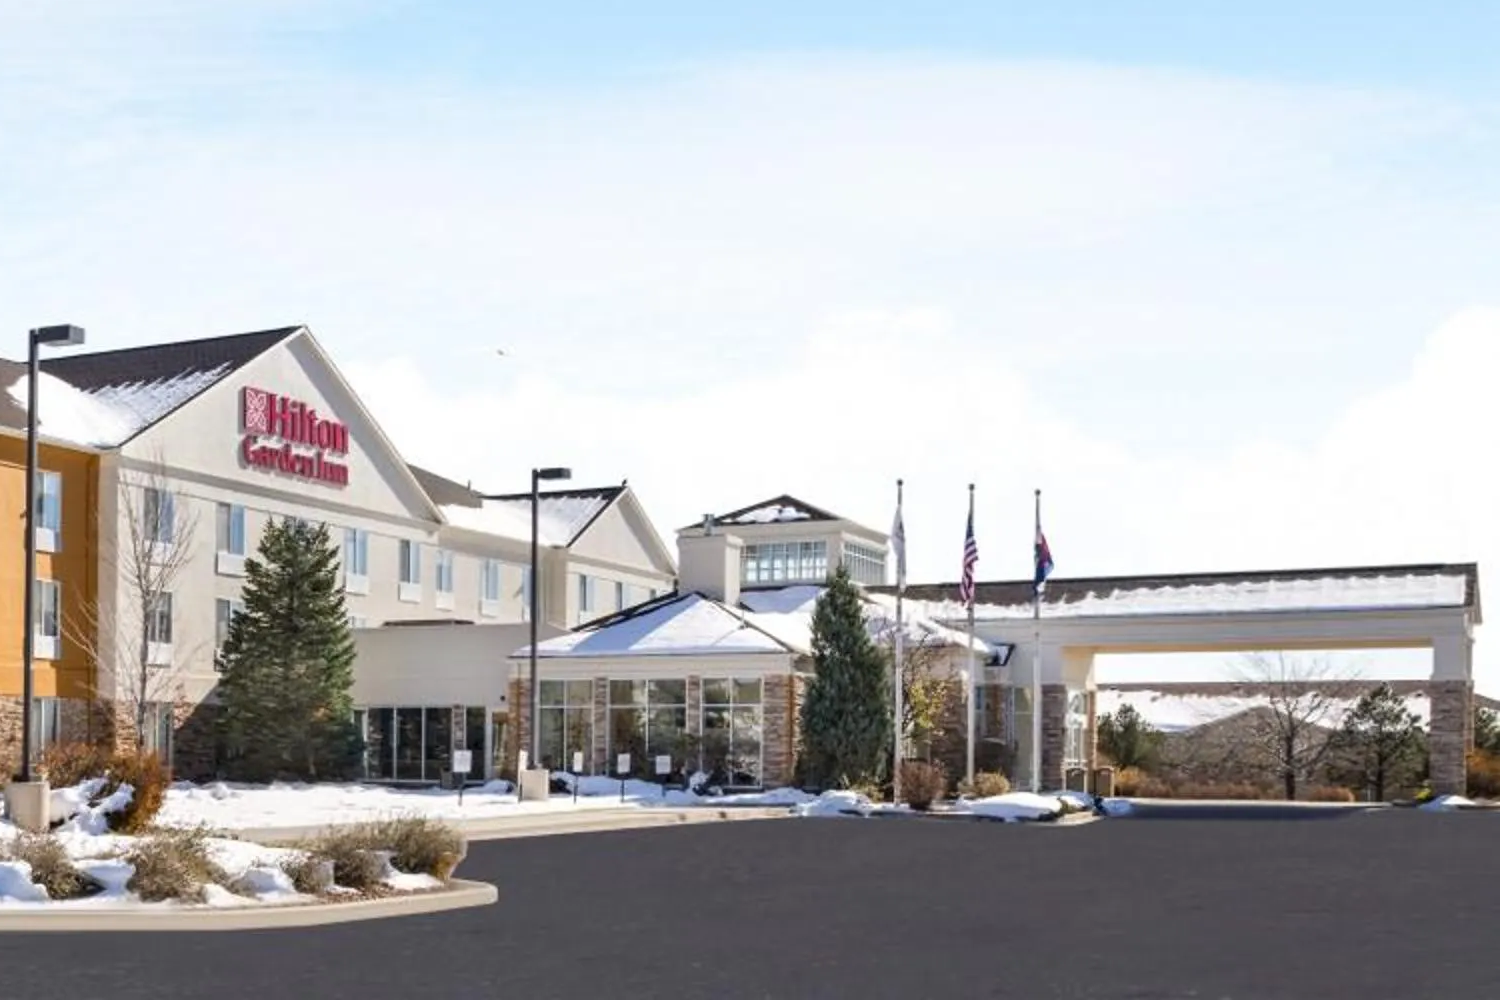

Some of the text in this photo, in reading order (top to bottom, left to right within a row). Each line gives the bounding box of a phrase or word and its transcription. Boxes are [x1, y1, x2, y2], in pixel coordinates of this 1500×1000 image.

[265, 393, 348, 454] Hilton
[243, 434, 348, 486] Garden Inn
